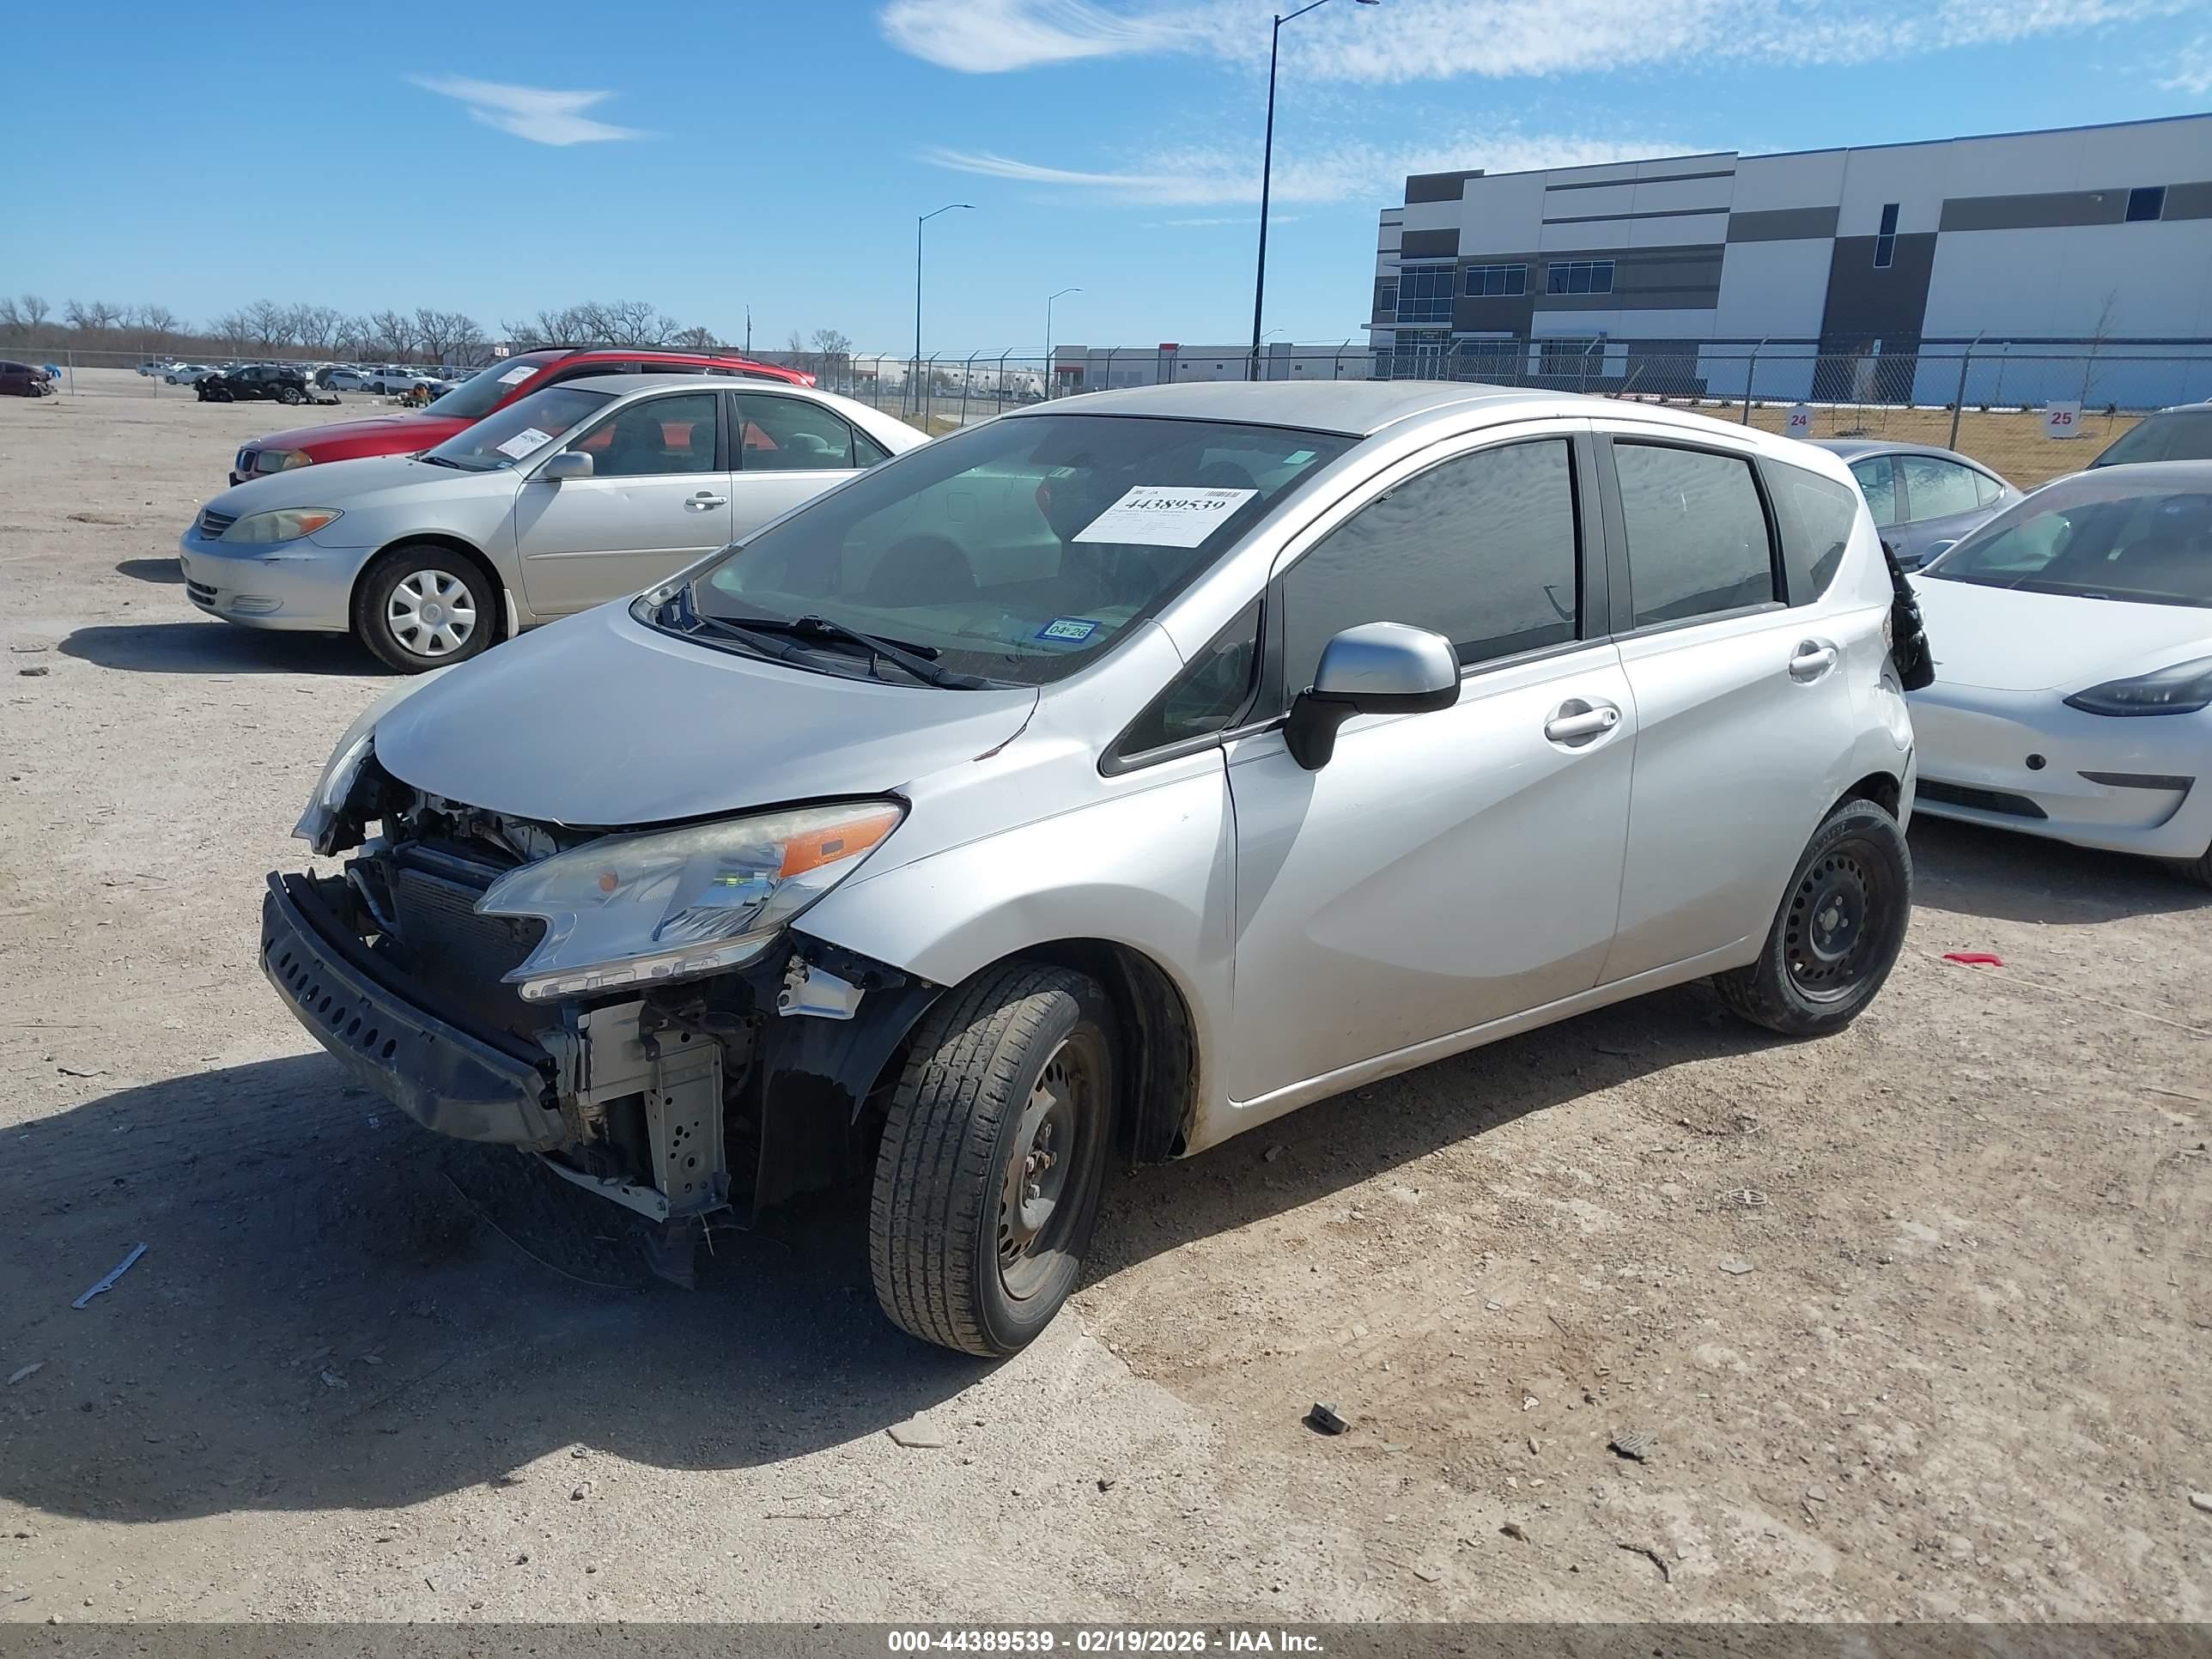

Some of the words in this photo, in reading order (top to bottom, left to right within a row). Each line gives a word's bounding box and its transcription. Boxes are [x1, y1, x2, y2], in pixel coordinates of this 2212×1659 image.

[1791, 414, 1807, 426] 24
[2051, 411, 2072, 425] 25
[1125, 499, 1226, 511] 44389539
[1049, 625, 1067, 635] 04
[1069, 628, 1089, 637] 26
